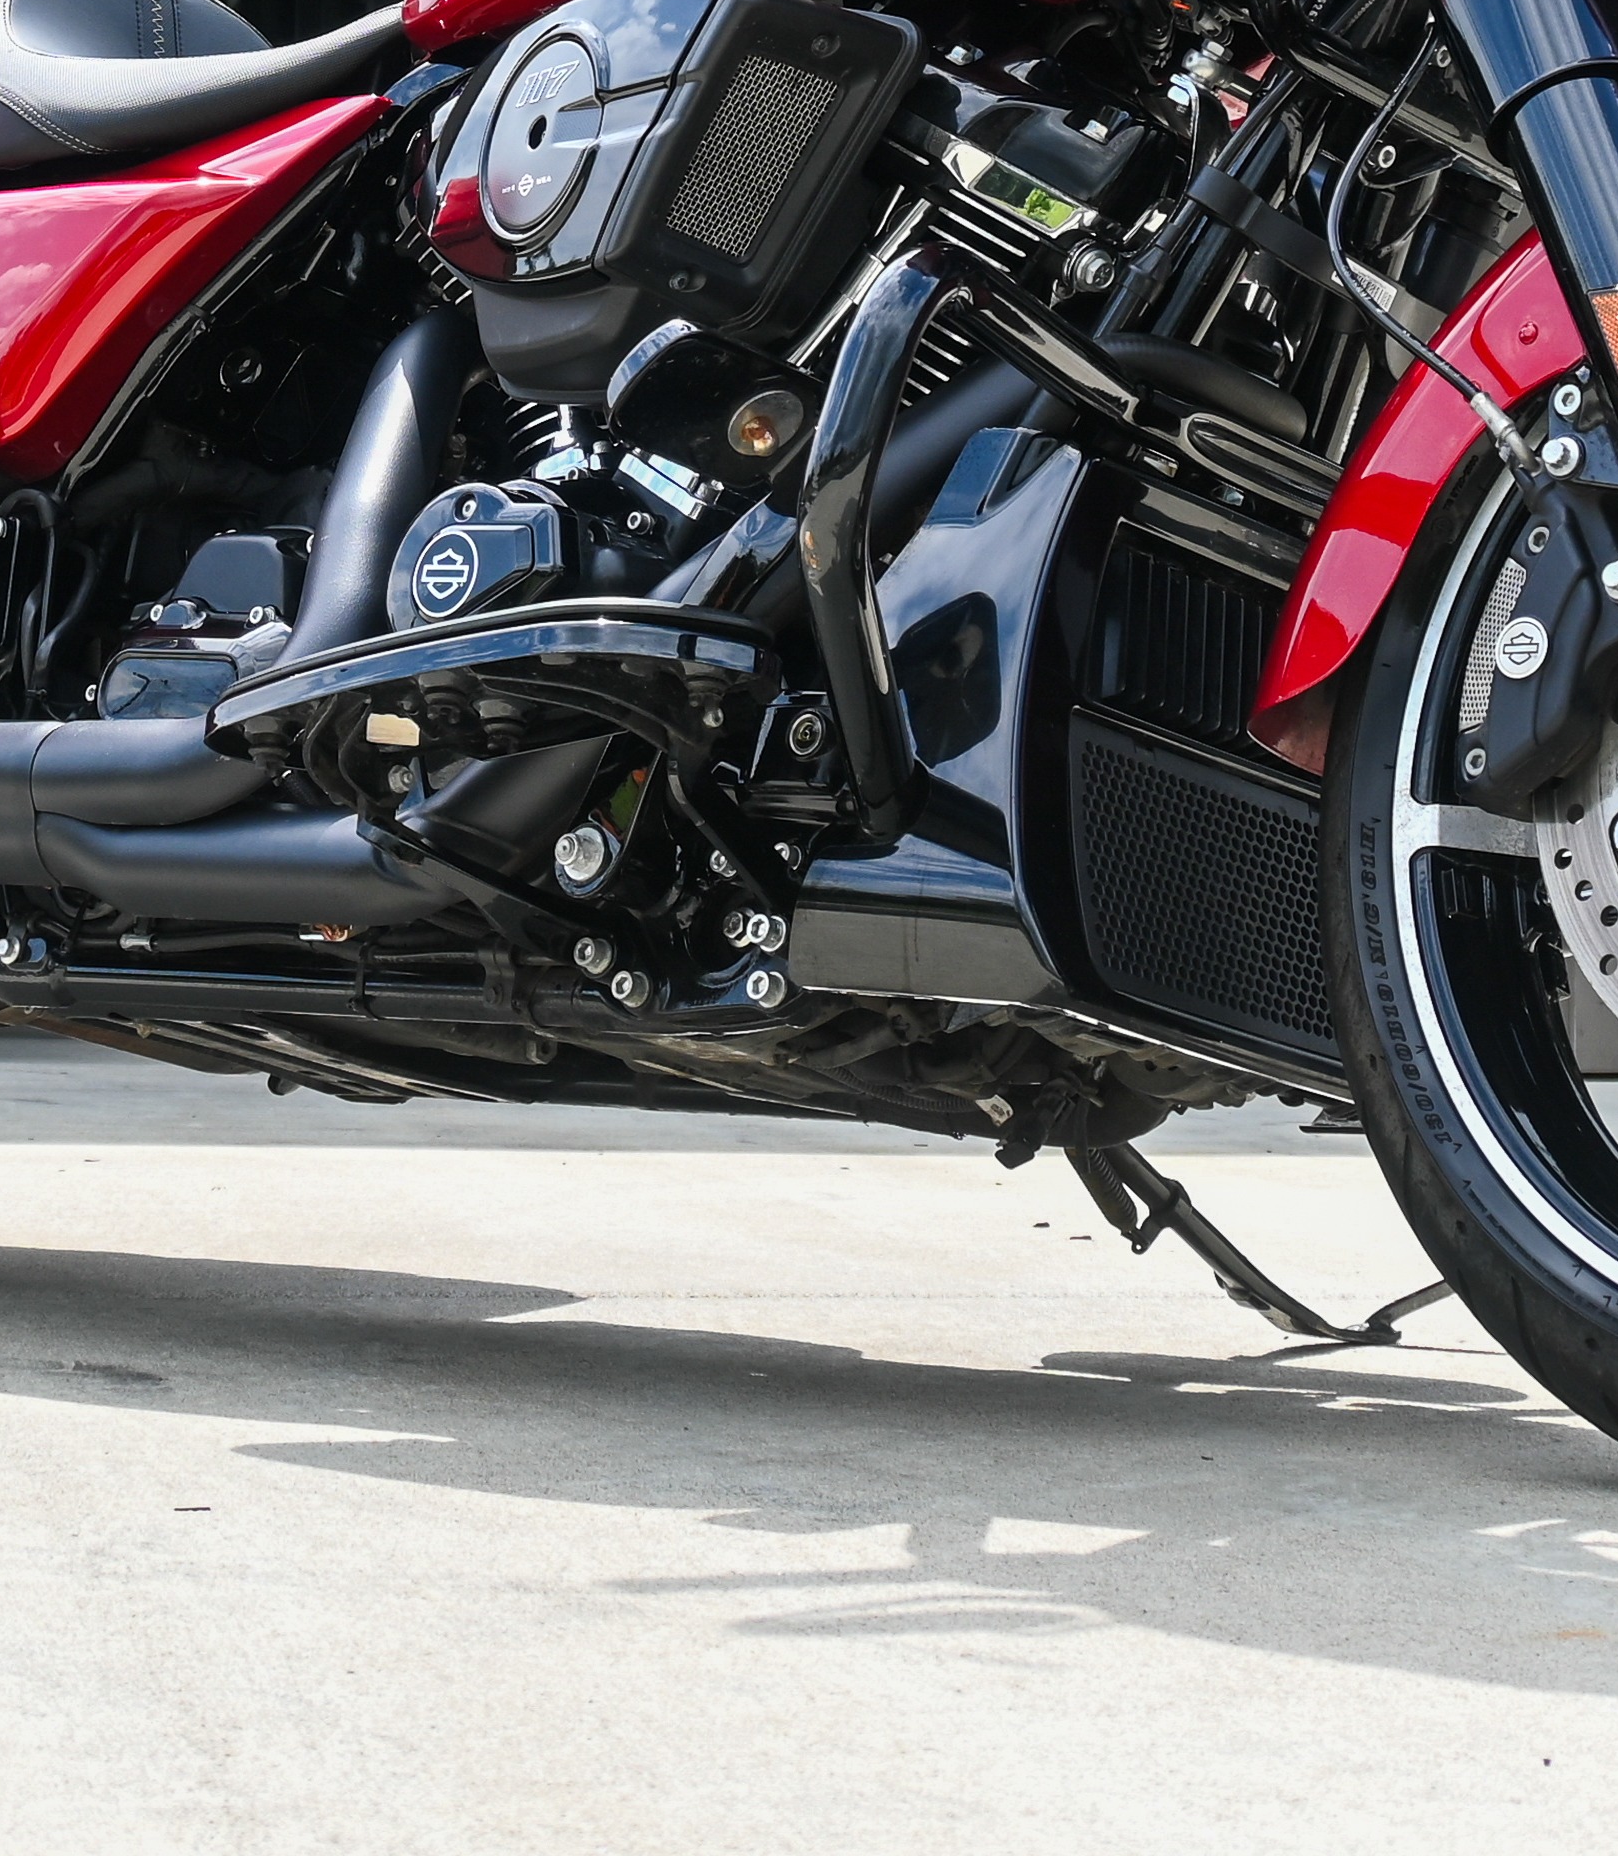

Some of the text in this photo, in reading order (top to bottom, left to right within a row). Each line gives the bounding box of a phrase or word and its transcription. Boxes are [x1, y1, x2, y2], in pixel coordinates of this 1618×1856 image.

[515, 59, 580, 109] 117
[1360, 822, 1376, 891] 61H
[1364, 901, 1387, 971] M/C
